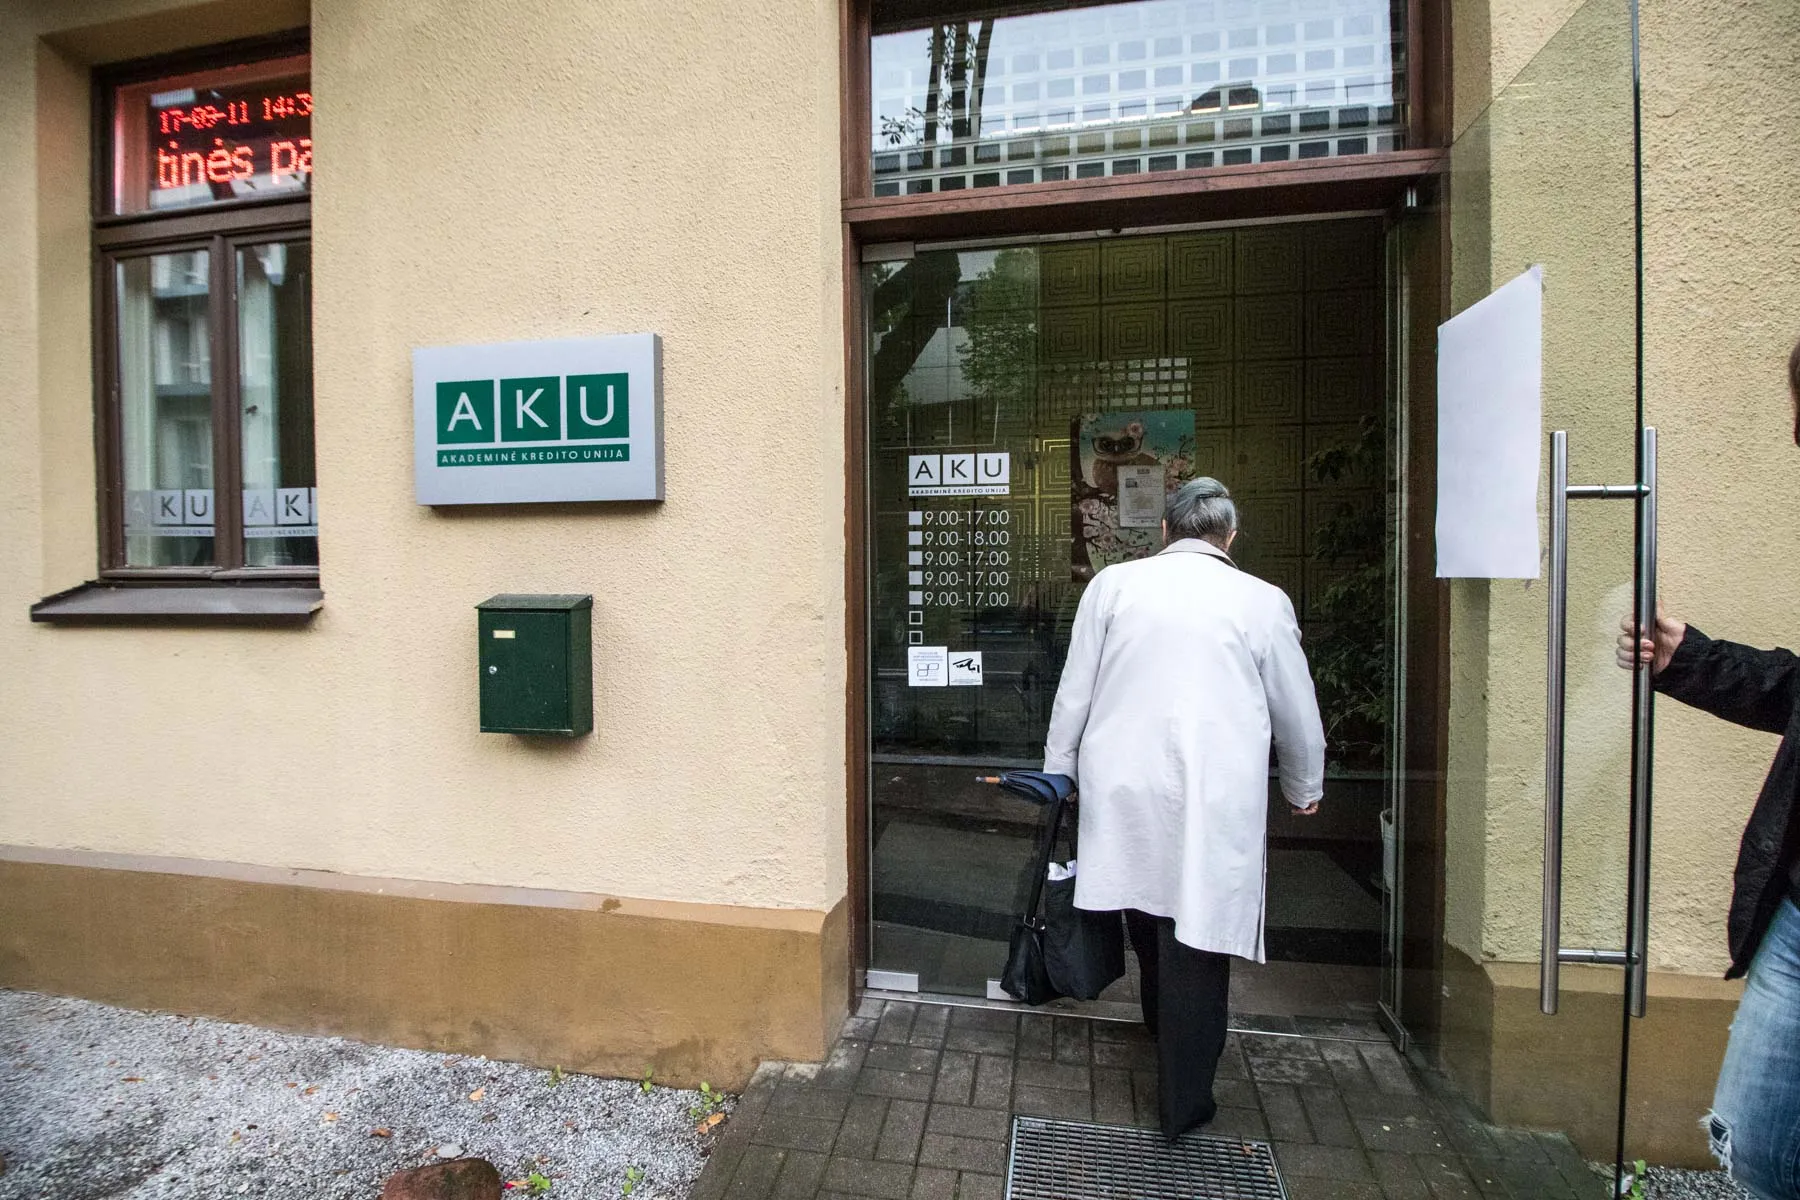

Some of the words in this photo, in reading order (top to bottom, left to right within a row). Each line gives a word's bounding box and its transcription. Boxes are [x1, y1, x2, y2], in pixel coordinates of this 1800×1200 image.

[446, 384, 616, 432] AKU
[441, 451, 516, 464] AKADEMINĖ
[521, 450, 578, 461] KREDITO
[583, 449, 624, 460] UNIJA
[914, 458, 1003, 480] AKU
[924, 510, 1010, 526] 9.00-17.00
[924, 530, 1010, 546] 9.00-18.00
[924, 550, 1010, 566] 9.00-17.00
[924, 571, 1010, 586] 9.00-17.00
[924, 591, 1010, 607] 9.00-17.00
